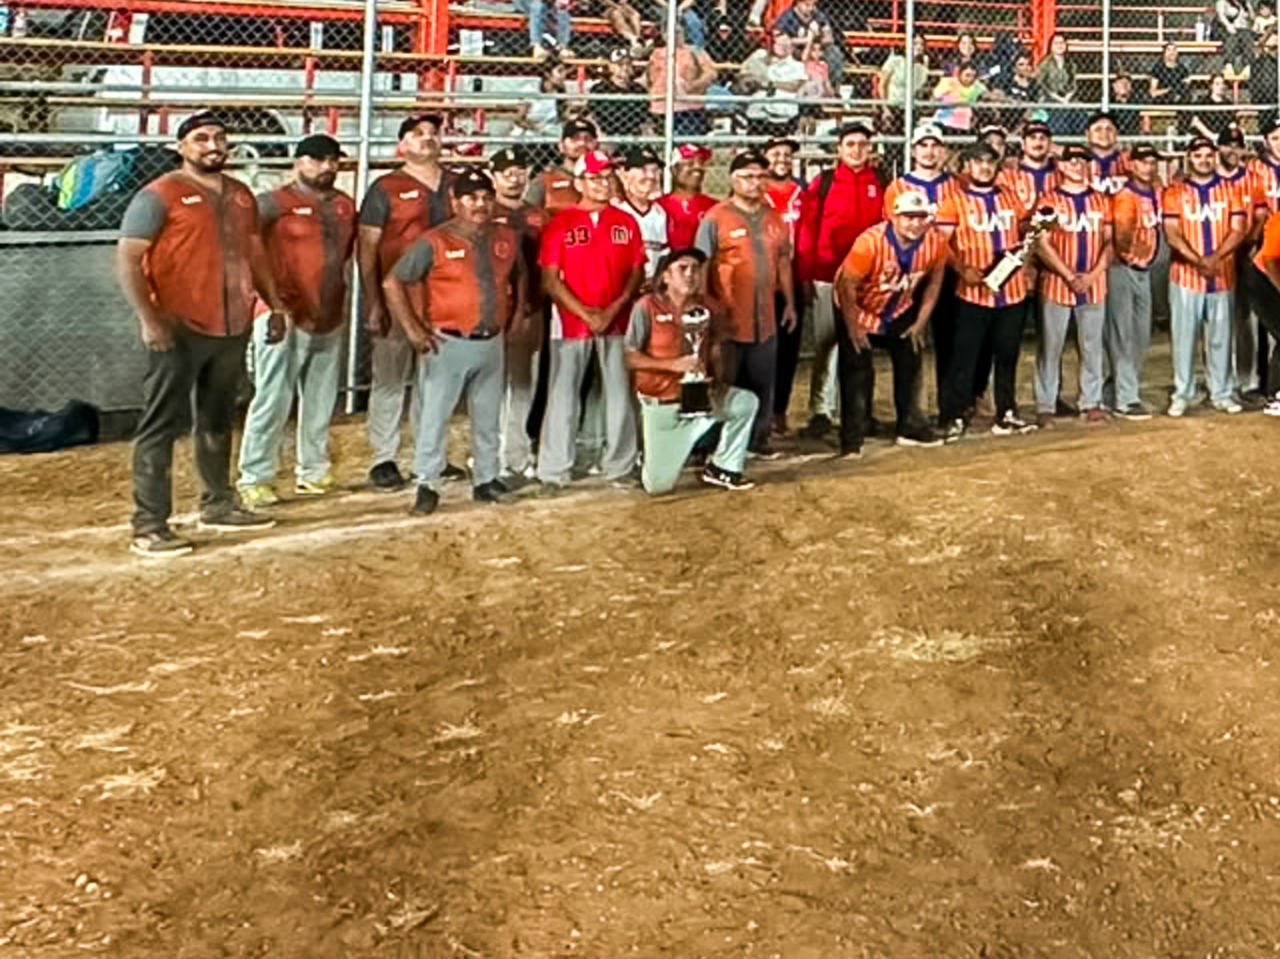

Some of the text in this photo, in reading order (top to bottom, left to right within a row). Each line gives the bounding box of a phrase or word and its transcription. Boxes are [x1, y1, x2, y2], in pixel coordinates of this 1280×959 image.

[969, 209, 1014, 232] UAT
[1058, 211, 1103, 232] UAT
[1183, 201, 1227, 222] UAT
